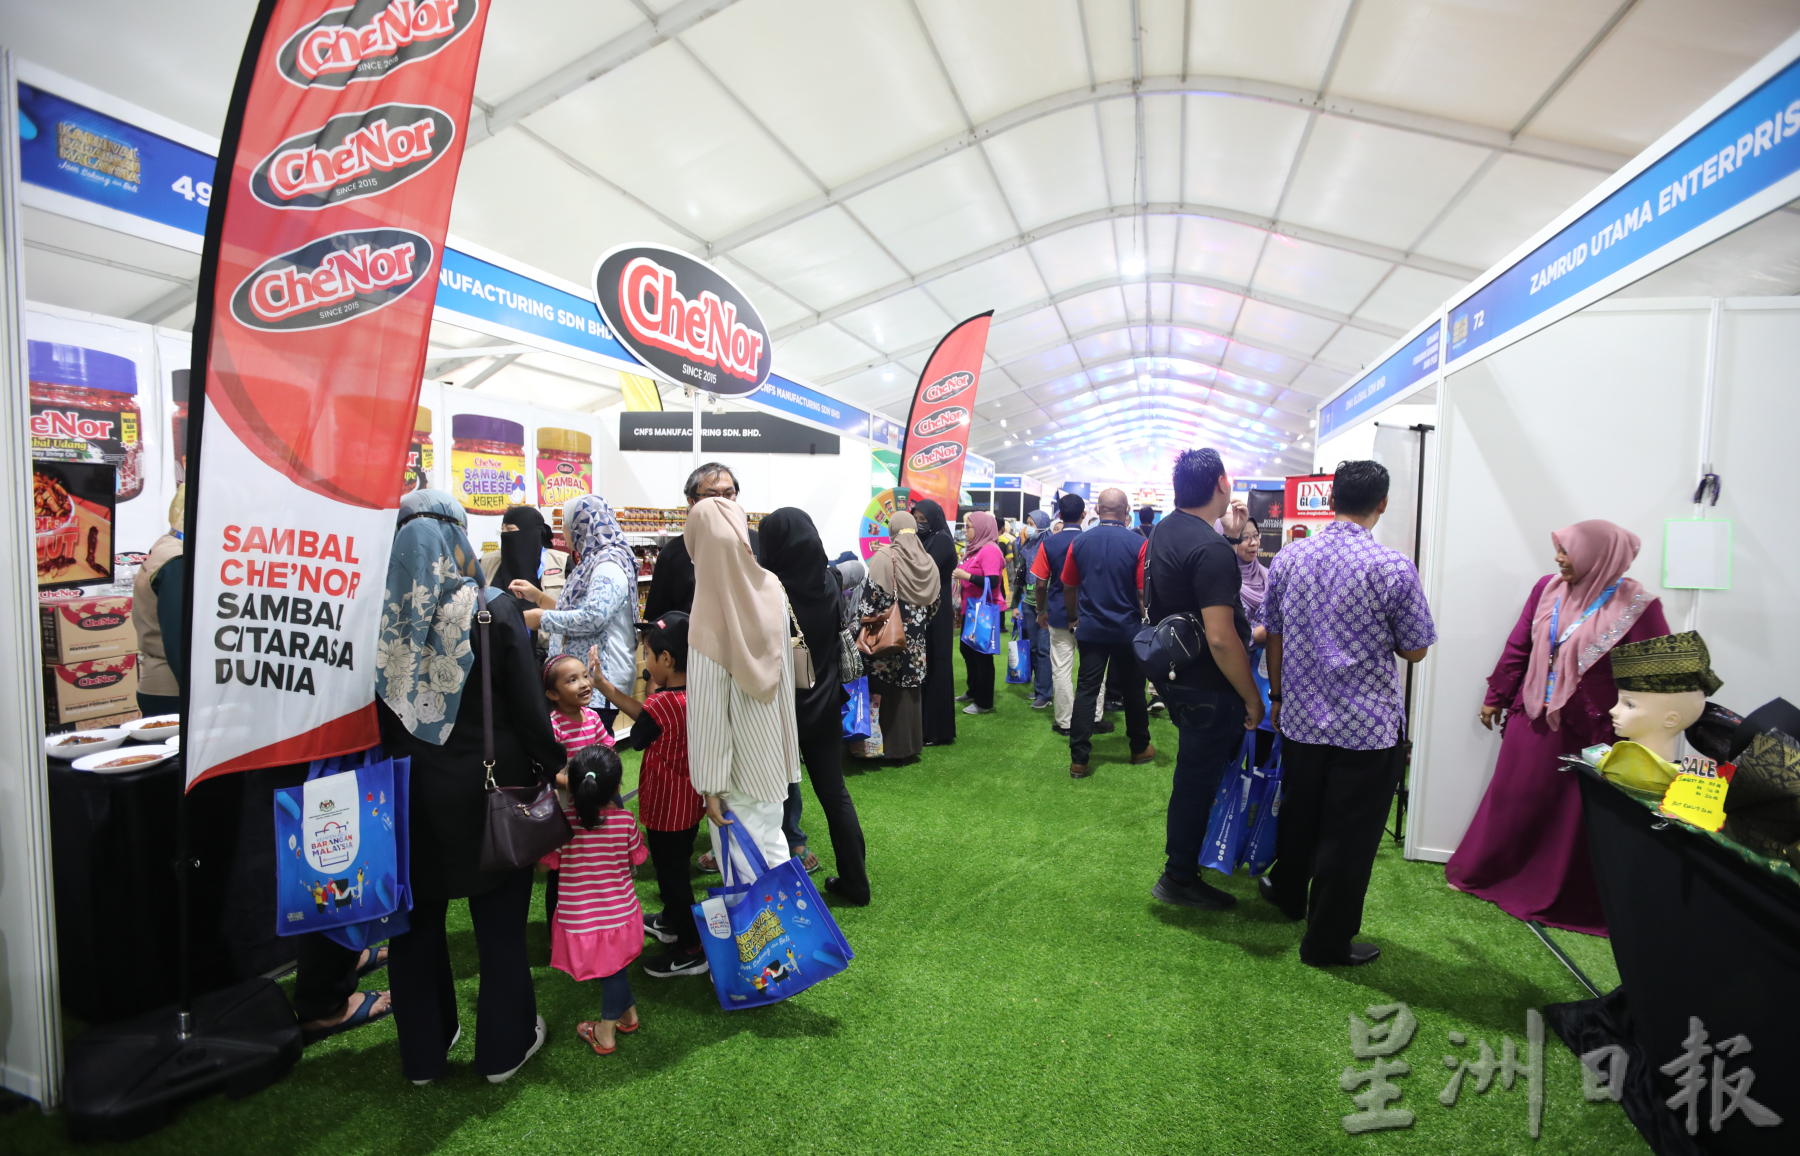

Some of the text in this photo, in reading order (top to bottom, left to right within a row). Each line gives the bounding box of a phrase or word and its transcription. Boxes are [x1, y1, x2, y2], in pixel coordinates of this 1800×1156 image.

[357, 60, 383, 72] SINCE
[57, 122, 140, 161] KARNIVAL
[58, 160, 79, 174] Jom
[59, 146, 141, 185] MALAYSIA
[335, 178, 378, 196] SINCE 2015
[1530, 243, 1587, 295] ZAMRUD
[1591, 200, 1653, 256] UTAMA
[248, 241, 415, 322] Che'Nor
[319, 301, 360, 319] SINCE 2015
[440, 268, 613, 341] NUFACTURING SDN BHD
[618, 257, 763, 383] Che'Nor
[1473, 310, 1485, 331] 72
[682, 364, 717, 384] SINCE 2015
[777, 387, 821, 412] MANUFACTURING
[821, 404, 831, 415] SDN
[831, 409, 841, 419] BHD
[30, 410, 114, 440] e'Nor
[634, 428, 761, 437] CNFS MANUFACRING SDN. BHD.
[53, 439, 87, 451] Udang
[462, 481, 513, 494] CHEESE
[464, 468, 511, 481] SAMBAL
[547, 476, 585, 491] SAMBAL
[473, 495, 504, 507] KOREA
[36, 532, 79, 559] NUT
[222, 525, 359, 564] SAMBAL
[220, 558, 361, 600] CHE'NOR
[216, 592, 344, 631] SAMBAL
[214, 625, 354, 671] CITARASA
[215, 658, 316, 696] DUNIA
[65, 702, 89, 711] Sambal
[1679, 756, 1717, 778] SALE
[311, 834, 353, 850] BARANGAN
[312, 842, 353, 858] MALAYSIA
[736, 908, 776, 945] ARNIVAL
[739, 915, 781, 953] ARANGAN
[740, 925, 786, 963] ALAYSIA
